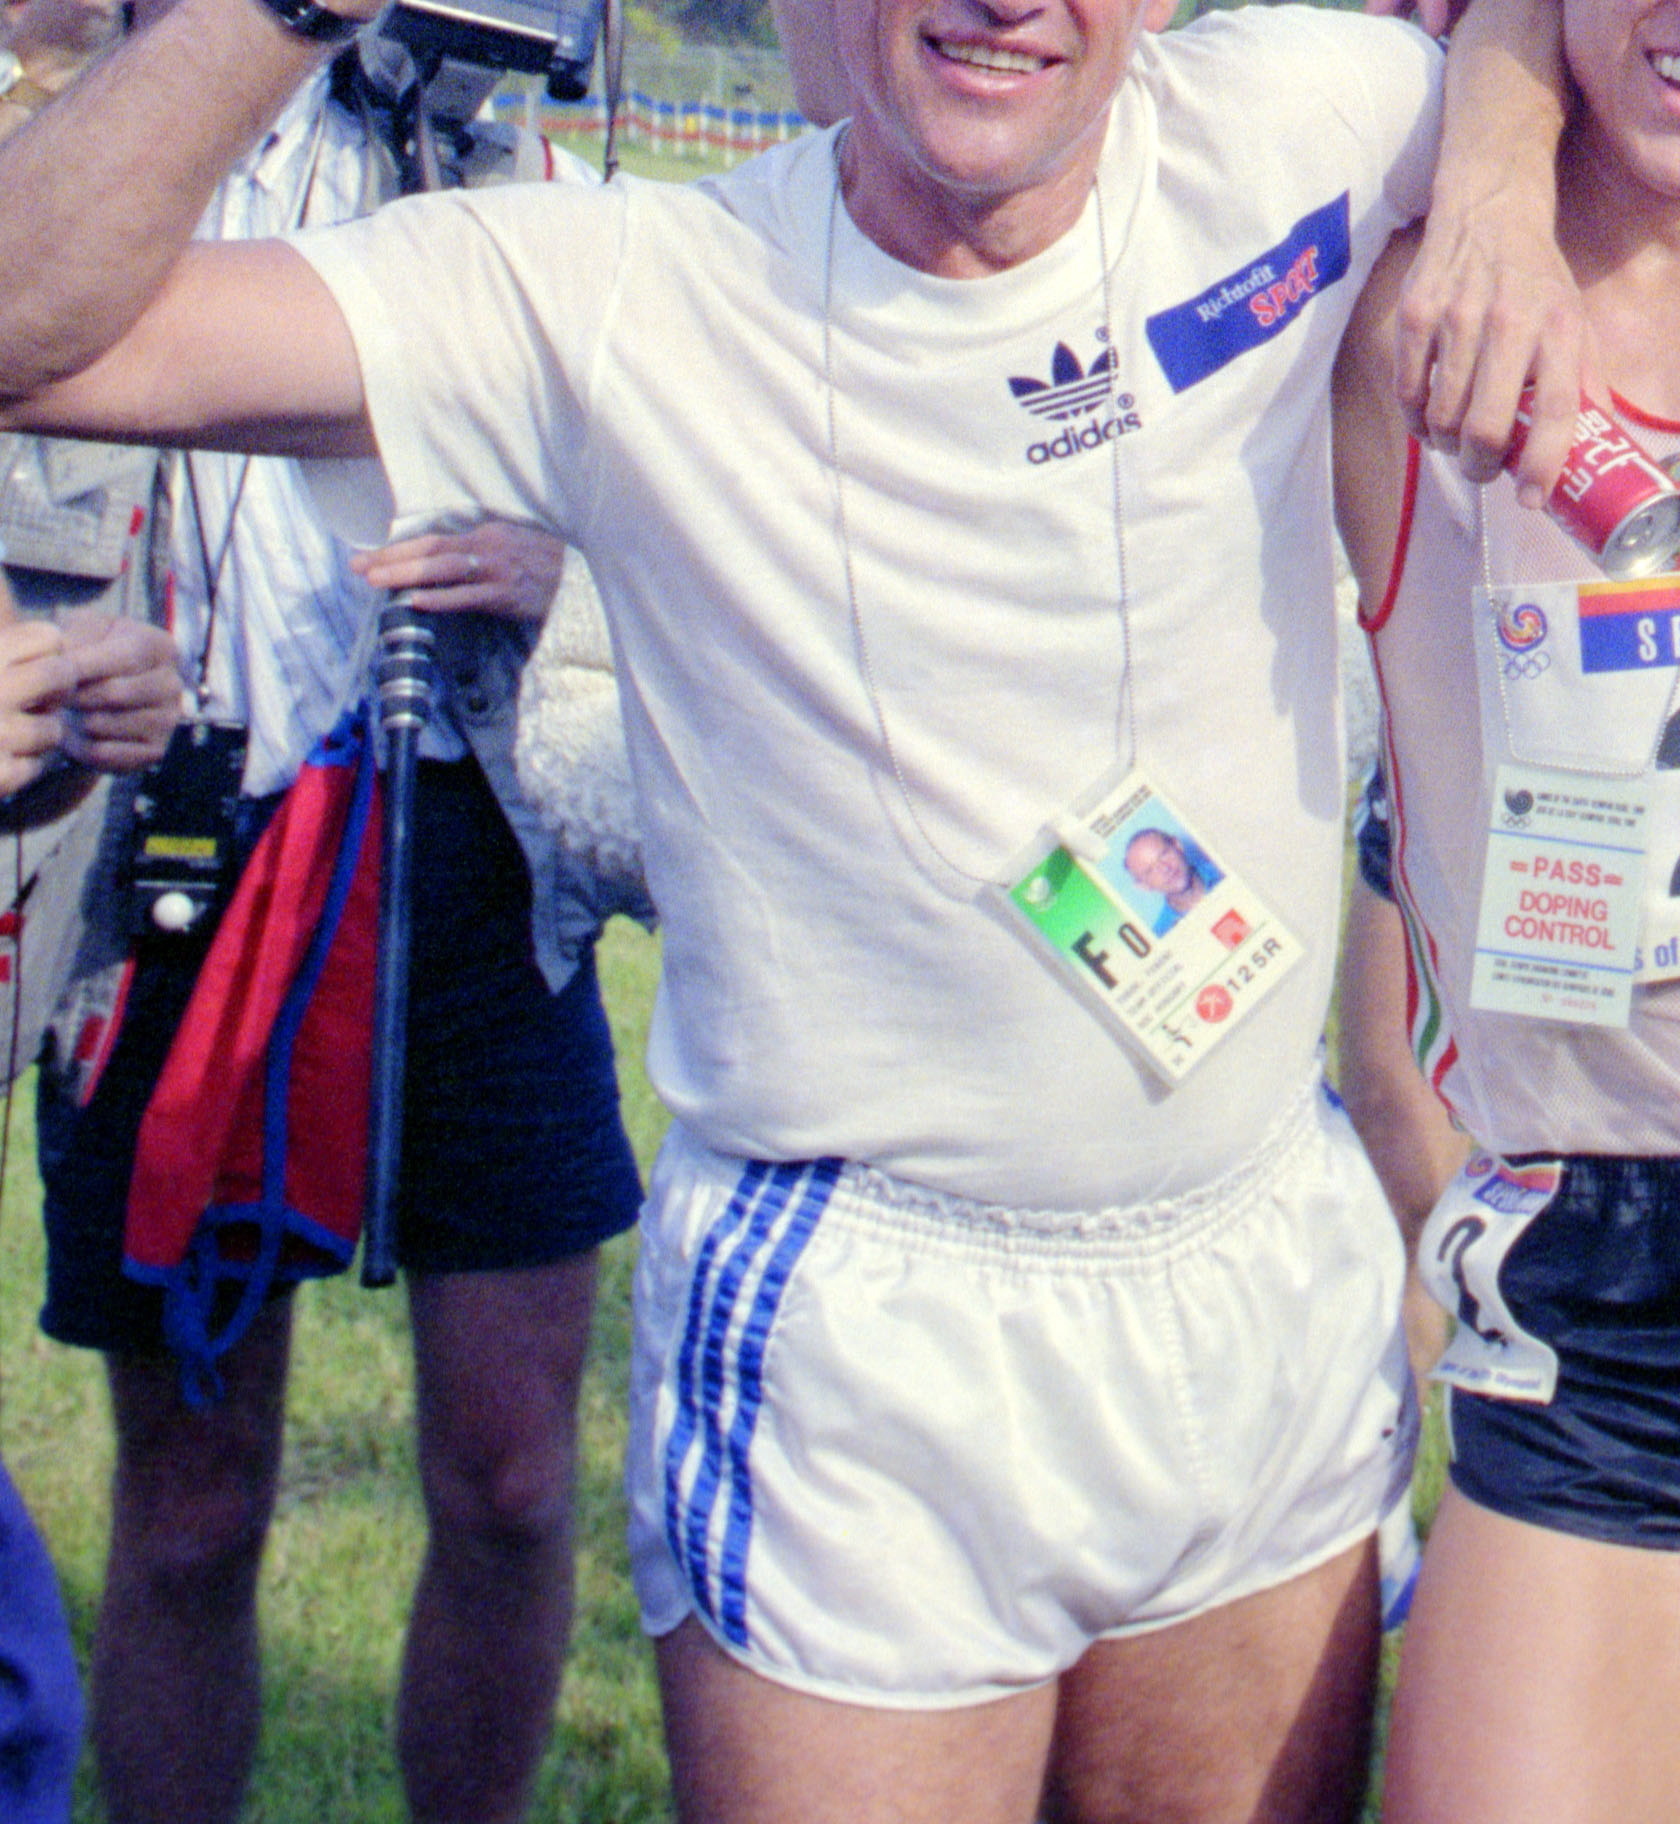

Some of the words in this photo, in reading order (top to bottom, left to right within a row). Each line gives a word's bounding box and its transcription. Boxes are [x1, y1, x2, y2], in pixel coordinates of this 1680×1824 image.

[1196, 264, 1275, 323] Richtofit
[1250, 245, 1318, 327] SPORT
[1026, 412, 1143, 465] adidas
[1533, 856, 1602, 887] PASS
[1519, 890, 1608, 922] DOPING
[1504, 914, 1616, 951] CONTROL
[1654, 937, 1680, 969] of
[1071, 930, 1119, 990] F
